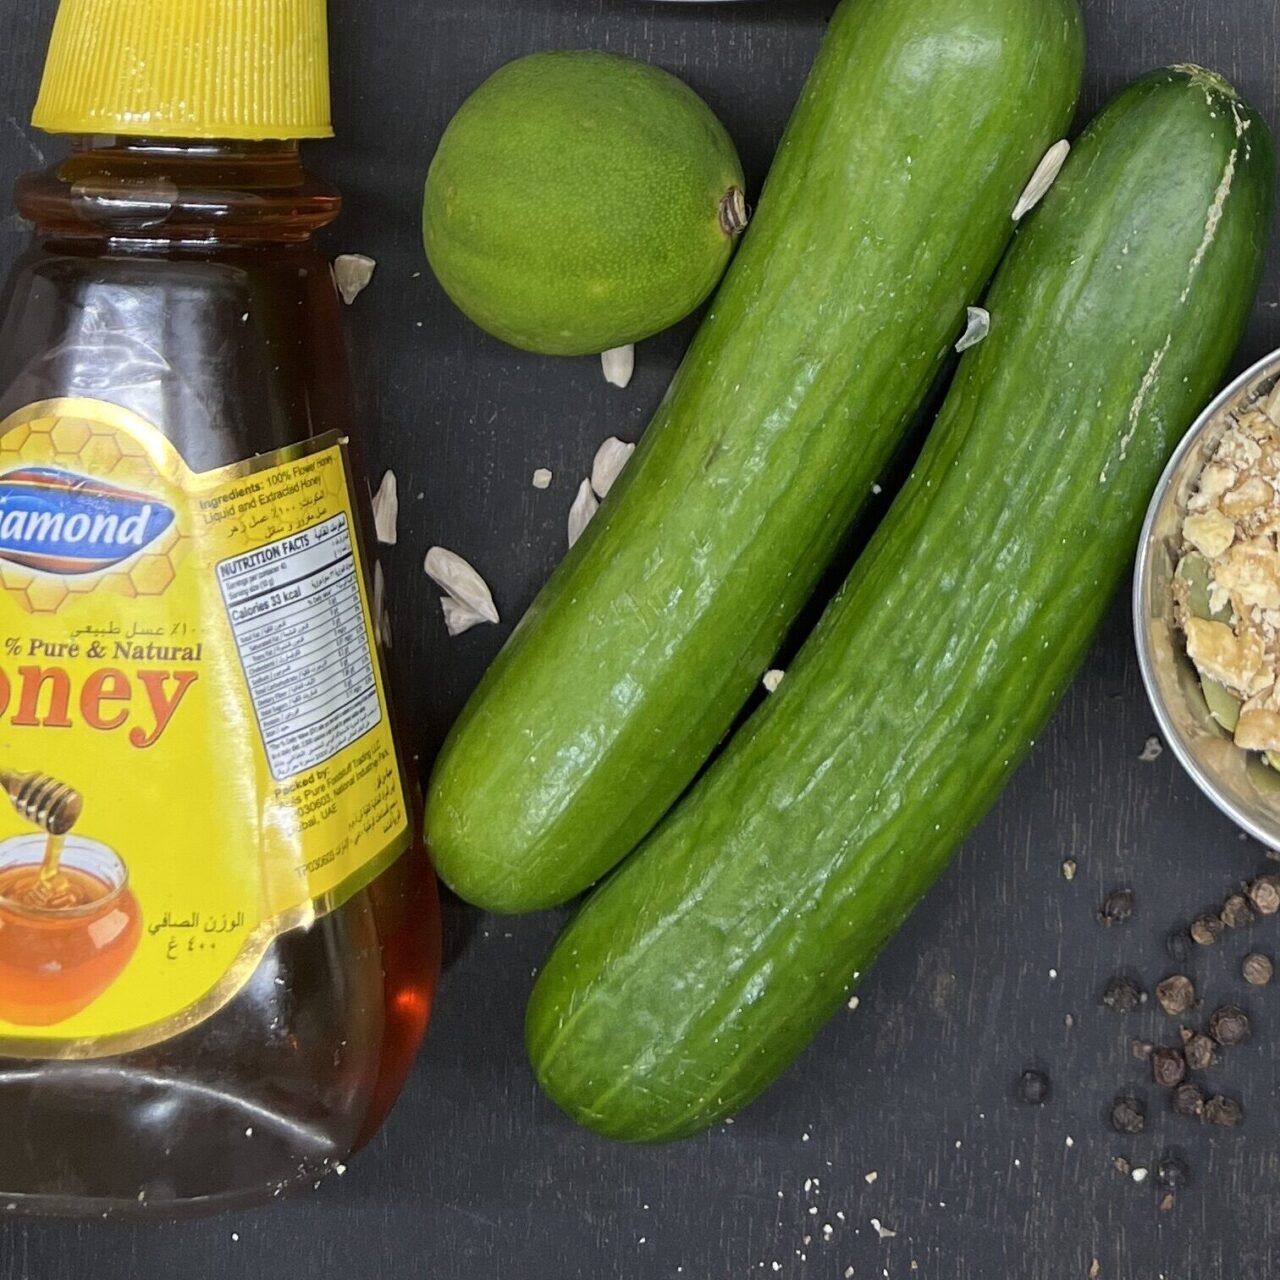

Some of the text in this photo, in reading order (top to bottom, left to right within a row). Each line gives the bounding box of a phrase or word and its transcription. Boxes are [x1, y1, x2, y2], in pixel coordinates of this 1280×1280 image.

[198, 484, 264, 511] Ingredients:
[266, 471, 291, 488] 100%
[202, 475, 322, 524] Liquid and Extracted Honey
[0, 505, 152, 545] amond
[219, 545, 281, 578] NUTRITION
[281, 533, 310, 555] FACTS
[231, 587, 302, 622] Calories 33 kcal
[70, 621, 121, 639] طبيعي
[126, 622, 165, 639] عسل
[28, 638, 80, 658] Pure
[87, 641, 107, 659] &
[113, 641, 203, 662] Natural
[0, 665, 199, 749] ney
[273, 766, 330, 799] Packed by:
[303, 783, 326, 801] Pure
[320, 802, 339, 821] UAE
[148, 911, 245, 937] الوزن الصافي
[166, 936, 217, 961] ٤٠٠ غ
